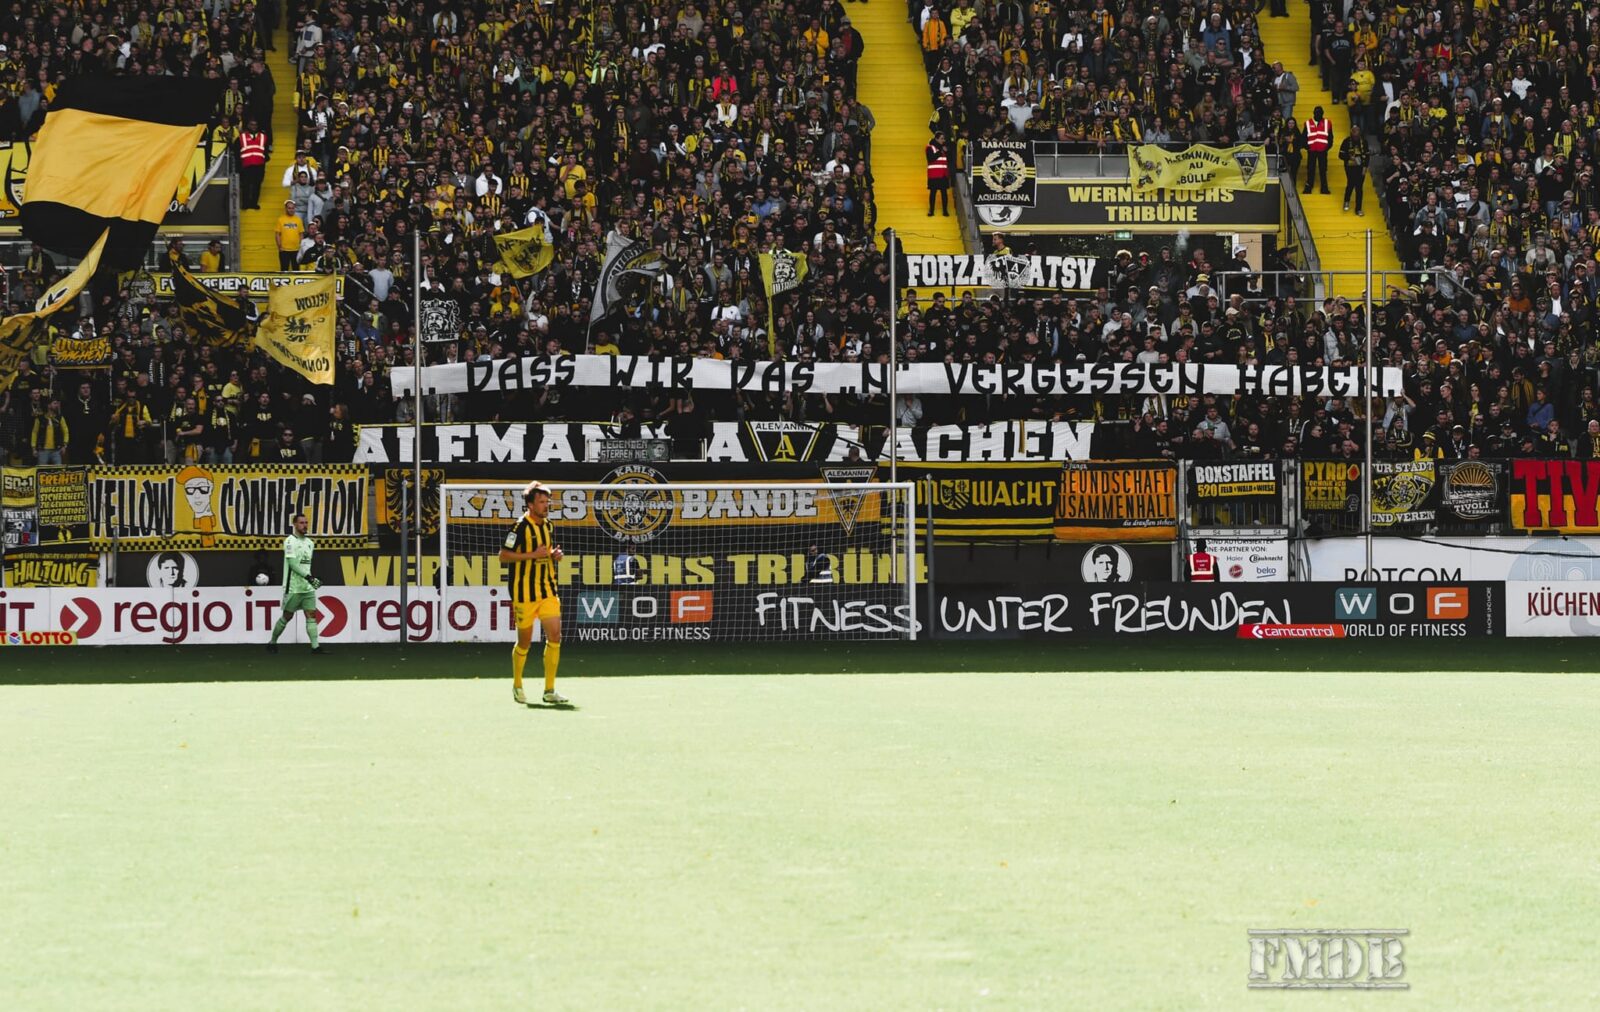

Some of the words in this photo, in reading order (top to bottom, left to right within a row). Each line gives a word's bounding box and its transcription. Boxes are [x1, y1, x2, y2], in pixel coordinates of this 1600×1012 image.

[981, 141, 1027, 149] RABAUKEN
[1189, 161, 1204, 170] AU
[977, 193, 1030, 202] AQUISGRANA
[1068, 186, 1158, 203] WERNER
[1164, 187, 1235, 203] FUCHS
[1105, 203, 1198, 222] TRIBÜNE
[906, 255, 986, 287] FORZA
[466, 353, 576, 393] DASS
[609, 354, 695, 388] WIR
[730, 362, 815, 391] DAS
[944, 362, 1204, 395] VERGESSEN
[615, 464, 657, 478] KARLS
[827, 470, 871, 478] ALEMANNIA
[1195, 463, 1276, 484] BOXSTAFFEL
[1304, 462, 1347, 481] PYRO
[1396, 462, 1435, 472] STADT
[40, 472, 85, 485] FREIHEIT
[40, 492, 85, 502] SICHERHEIT
[972, 480, 1057, 506] WACHT
[1198, 484, 1217, 497] 520
[1305, 486, 1347, 501] KEIN
[1513, 459, 1600, 527] TIV
[90, 477, 175, 538] YELLOW
[220, 476, 365, 536] CONNECTION
[450, 489, 588, 520] KARS
[681, 488, 818, 519] BANDE
[1454, 502, 1489, 513] TIVOLI
[1250, 554, 1283, 563] Bauknecht
[13, 560, 88, 585] HALTUNG
[341, 555, 508, 586] WERNE
[1527, 586, 1600, 617] KÜCHEN
[114, 590, 233, 643] regio
[246, 589, 281, 631] iT
[755, 592, 923, 633] FITNESS
[940, 594, 1073, 633] UNTER
[1089, 590, 1292, 633] FREUNDEN
[23, 632, 73, 645] LOTTO
[578, 627, 628, 641] WORLD
[632, 627, 650, 641] OF
[653, 626, 711, 641] FITNESS
[1264, 625, 1336, 637] camcontrol
[1389, 623, 1407, 637] OF
[1411, 623, 1467, 637] FITNESS
